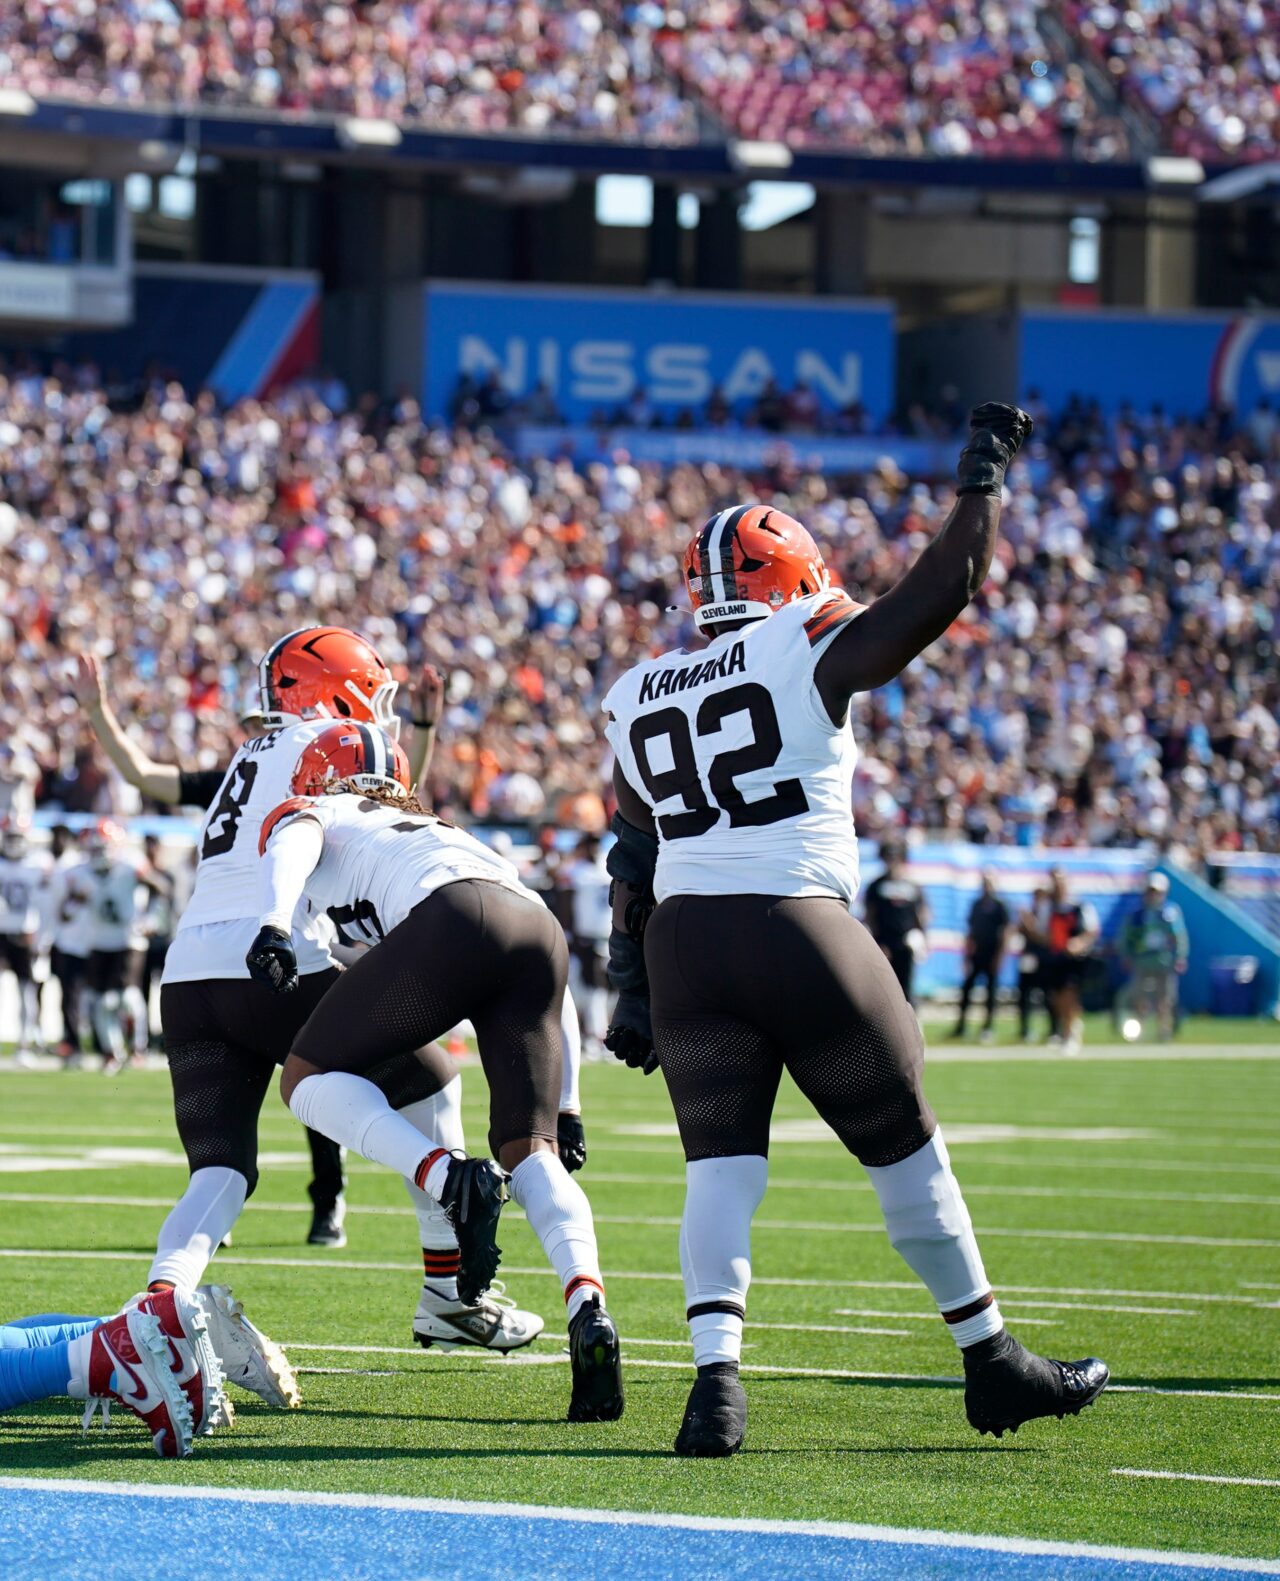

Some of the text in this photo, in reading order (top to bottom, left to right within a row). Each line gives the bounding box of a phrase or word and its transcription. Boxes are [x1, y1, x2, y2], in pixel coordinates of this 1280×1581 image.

[459, 336, 861, 405] NISSAN
[701, 604, 747, 619] CLEVELAND
[638, 641, 746, 704] KAMARA
[629, 682, 810, 841] 92
